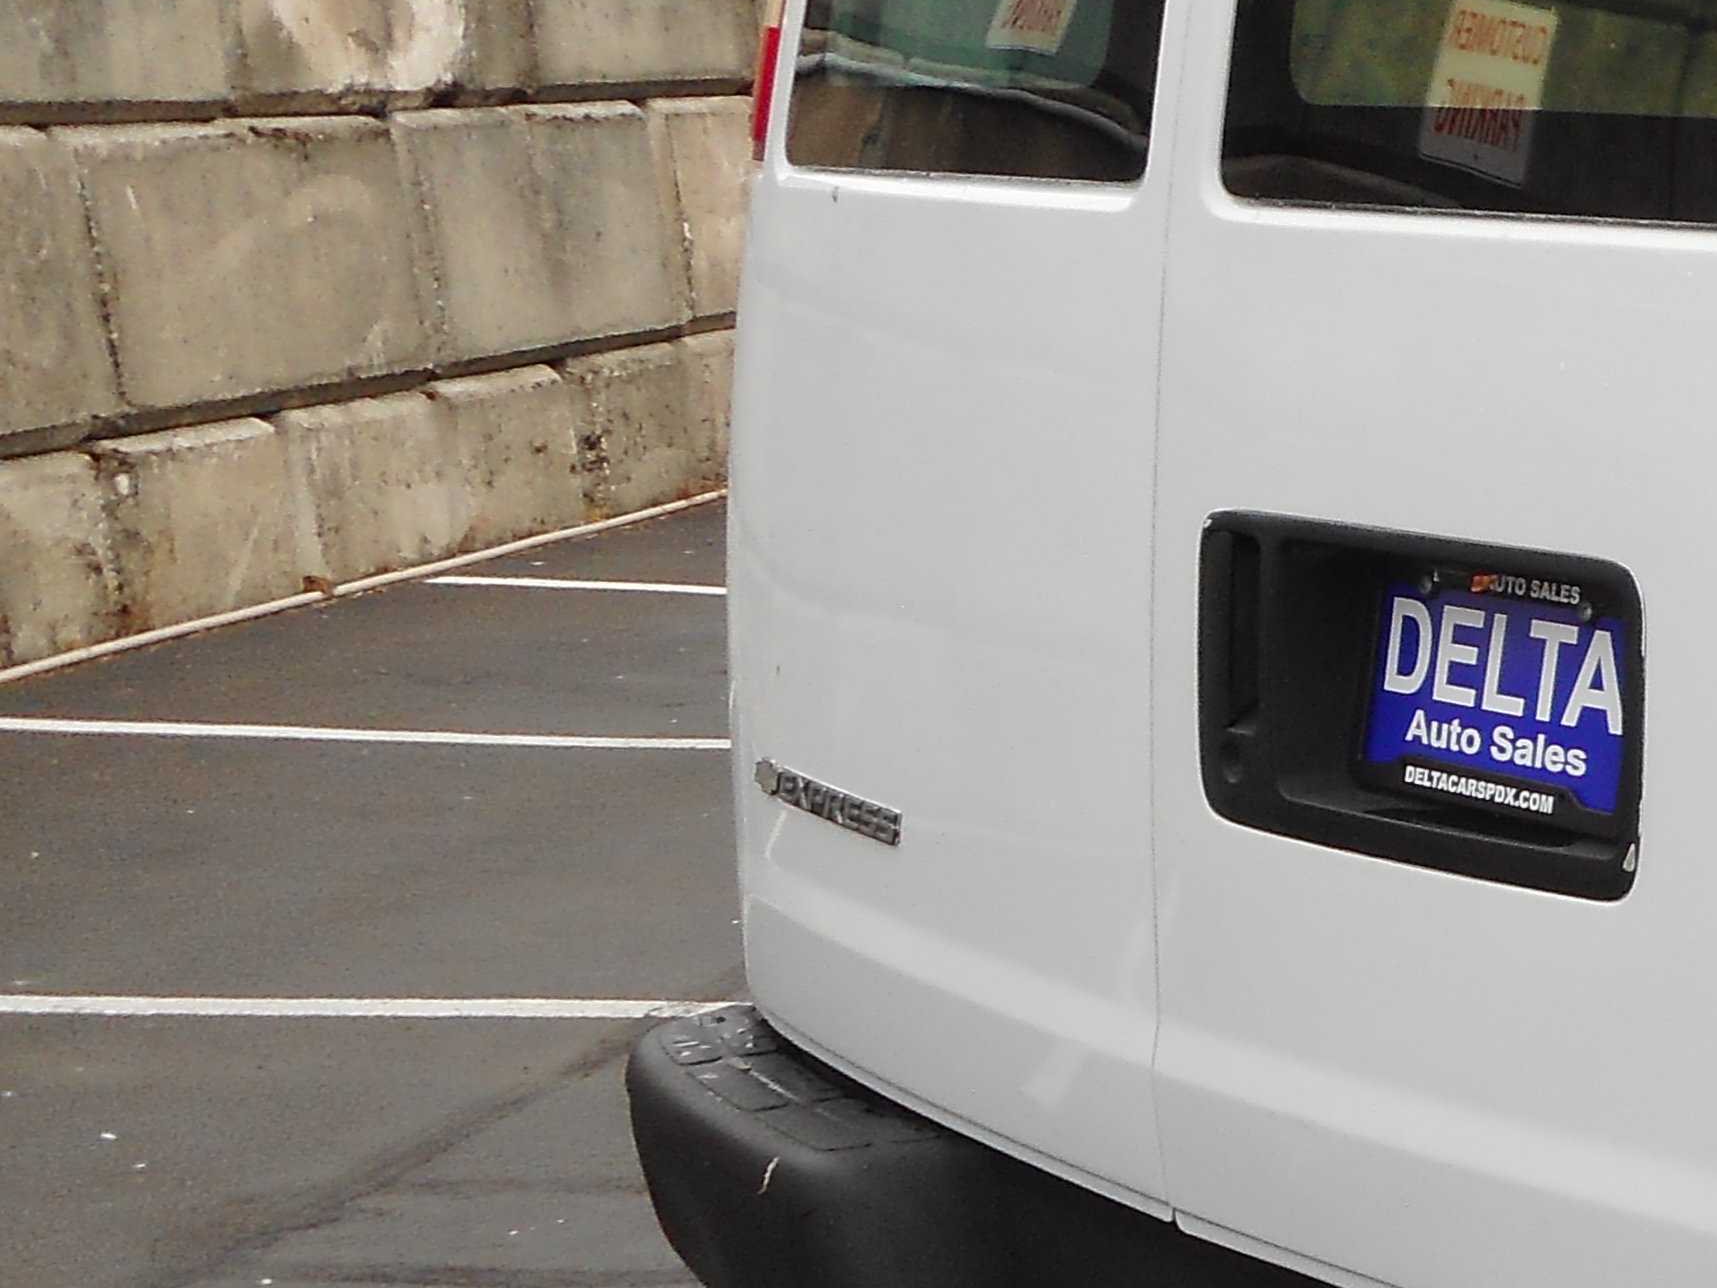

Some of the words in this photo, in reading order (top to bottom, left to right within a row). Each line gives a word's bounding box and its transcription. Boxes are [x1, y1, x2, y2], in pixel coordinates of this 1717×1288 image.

[1530, 580, 1580, 605] SALES
[1383, 596, 1624, 736] DELTA
[1405, 708, 1482, 755] Auto
[1490, 725, 1588, 778] Sales
[1404, 765, 1554, 814] DELTACARSPDX.COM
